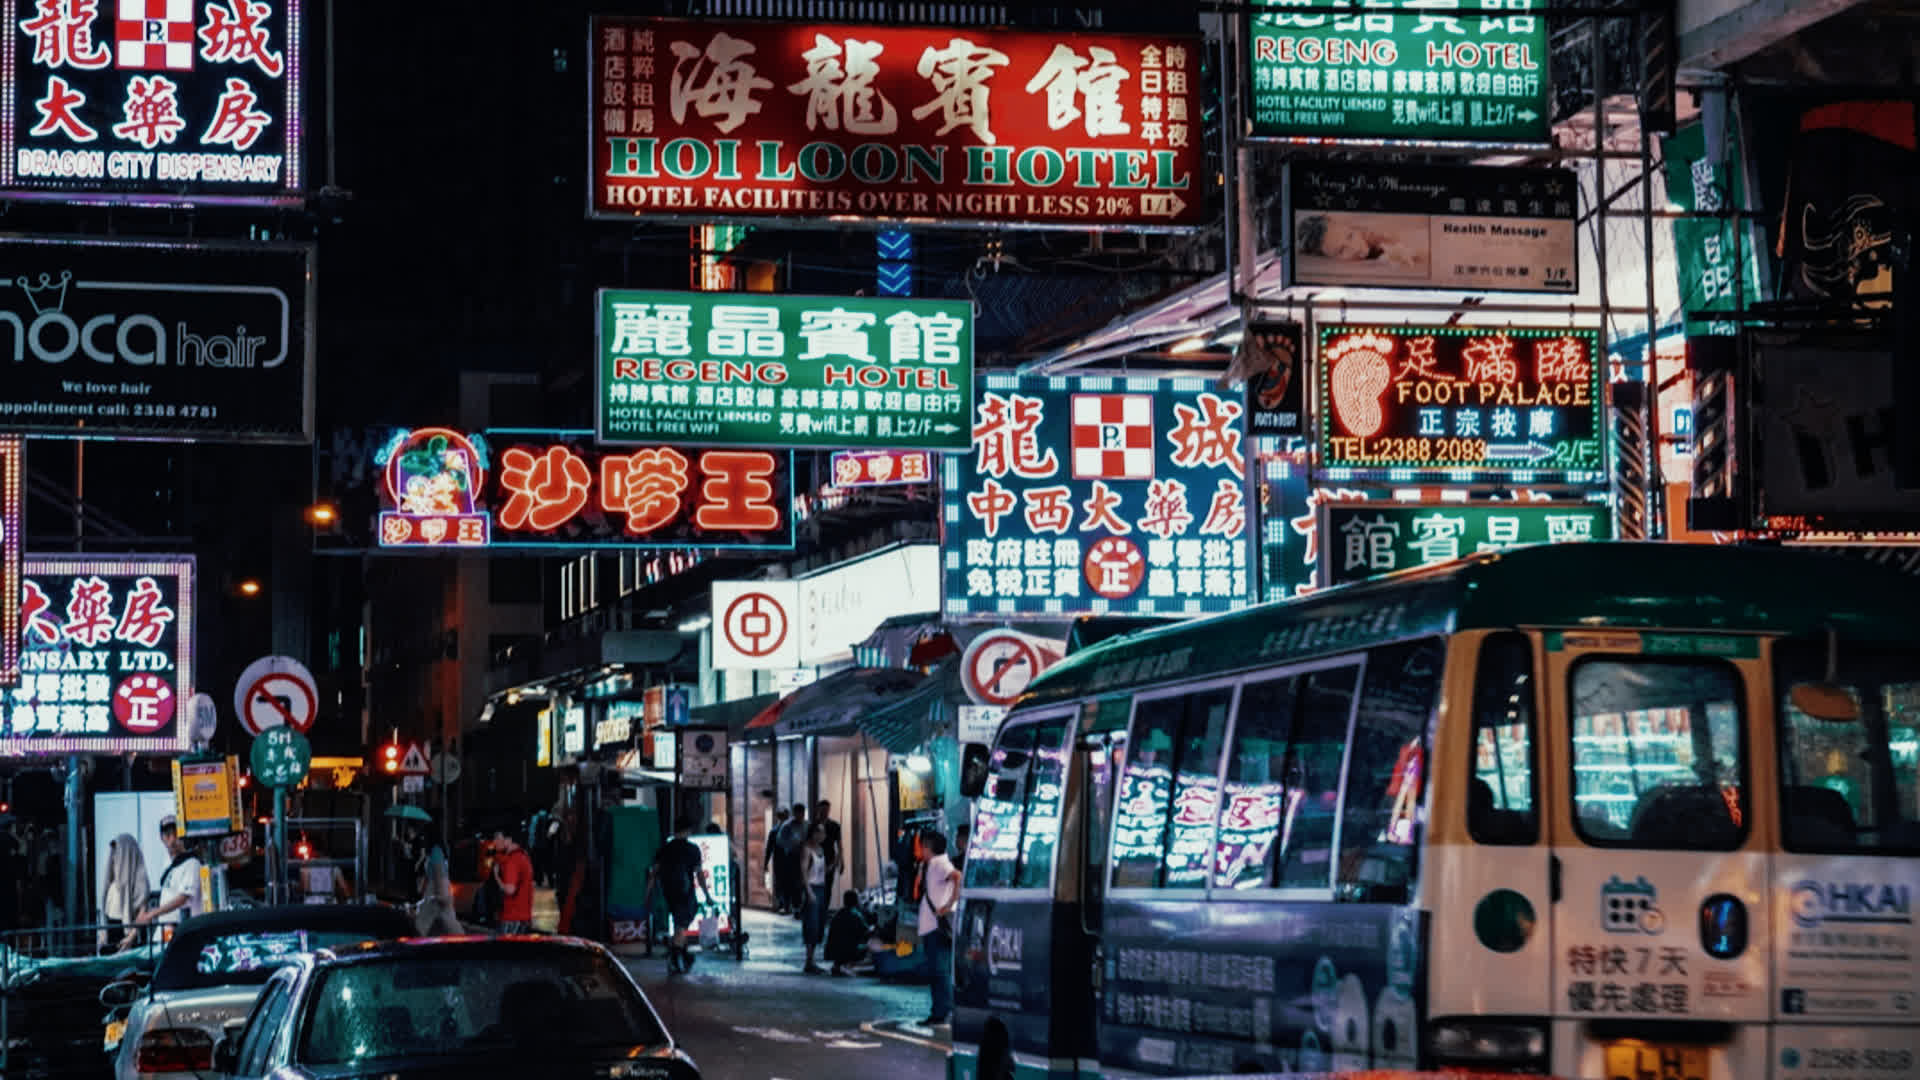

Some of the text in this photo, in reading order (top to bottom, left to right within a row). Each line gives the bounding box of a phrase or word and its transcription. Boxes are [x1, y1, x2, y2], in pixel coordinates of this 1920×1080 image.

[1255, 36, 1539, 69] REGENG HOTEL
[603, 27, 626, 132] 酒店設備
[669, 32, 1131, 138] 海龍賓館
[1141, 43, 1163, 145] 全日特平
[1165, 44, 1188, 147] 時租過夜
[30, 76, 272, 149] 大藥房
[1256, 96, 1293, 109] HOTEL
[1294, 97, 1341, 110] FACILITY
[1256, 111, 1293, 124] HOTEL
[1294, 112, 1319, 124] FREE
[18, 149, 282, 182] DRAGON CITY DISPENSARY
[606, 136, 1190, 189] HOI LOON HOTEL
[606, 184, 1133, 217] HOTEL FACILITEIS OVER NIGHT LESS 20%
[1443, 223, 1548, 239] Health Massage
[176, 321, 266, 368] hair
[610, 302, 965, 365] 麗晶賓館
[62, 380, 152, 395] We love hair
[612, 357, 959, 391] REGENG HOTEL
[1396, 381, 1592, 406] FOOT PALACE
[134, 403, 176, 417] 2388
[180, 405, 217, 418] 4781
[609, 407, 653, 420] HOTEL
[656, 409, 713, 422] FACILITY
[1418, 408, 1554, 437] 正宗按摩
[609, 421, 653, 433] HOTEL
[656, 423, 687, 434] FREE
[1436, 438, 1487, 462] 2093
[1556, 440, 1595, 462] 2/F
[500, 446, 779, 532] 沙嗲王
[966, 478, 1246, 540] 中西大藥房
[966, 538, 1081, 567] 政府註冊
[1098, 560, 1131, 592] 正
[119, 651, 175, 671] LTD.
[127, 697, 159, 727] 正
[1568, 944, 1689, 977] 特快7天
[1568, 981, 1690, 1014] 優先處理
